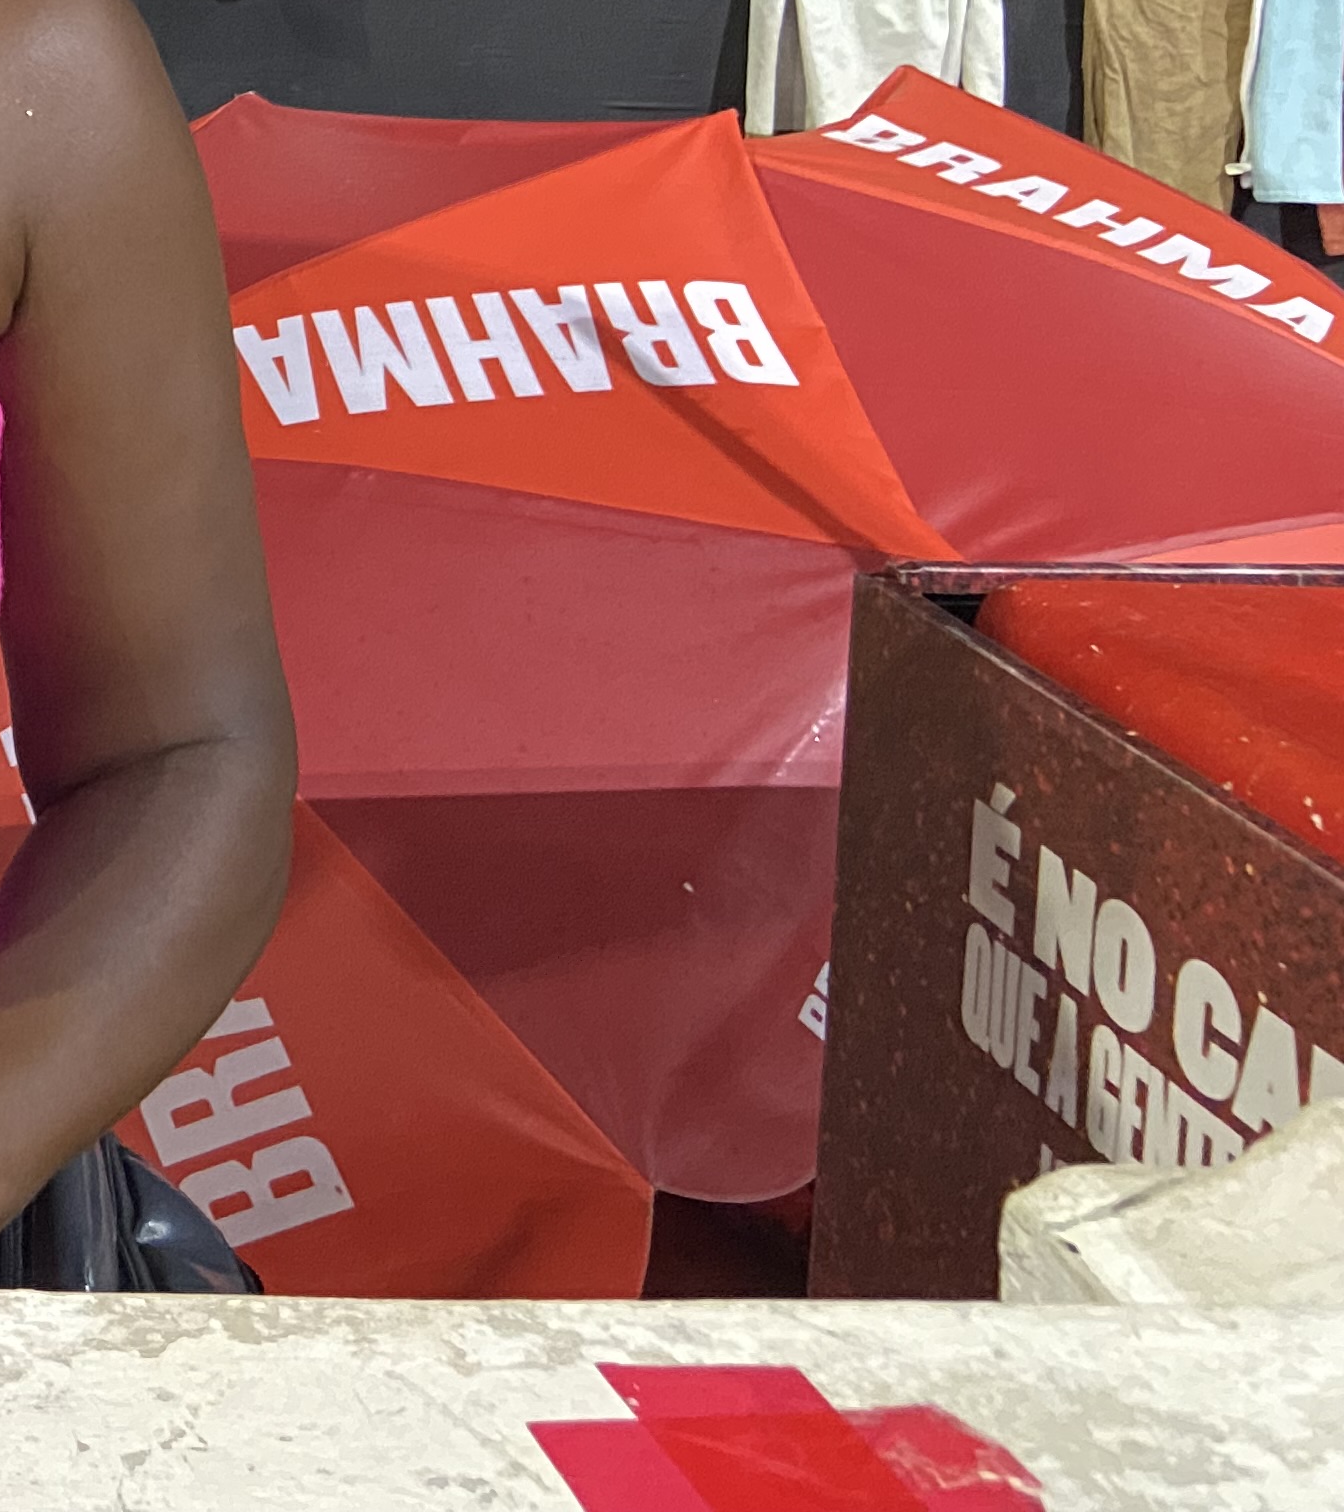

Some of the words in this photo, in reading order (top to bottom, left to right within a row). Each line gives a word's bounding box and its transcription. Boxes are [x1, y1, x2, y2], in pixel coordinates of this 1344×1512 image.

[821, 114, 1335, 343] BRAHMA
[232, 280, 800, 426] BRAHMA
[968, 782, 1022, 939] É
[1033, 844, 1157, 1035] NO
[961, 922, 1048, 1096] QUE
[1044, 993, 1079, 1128] A
